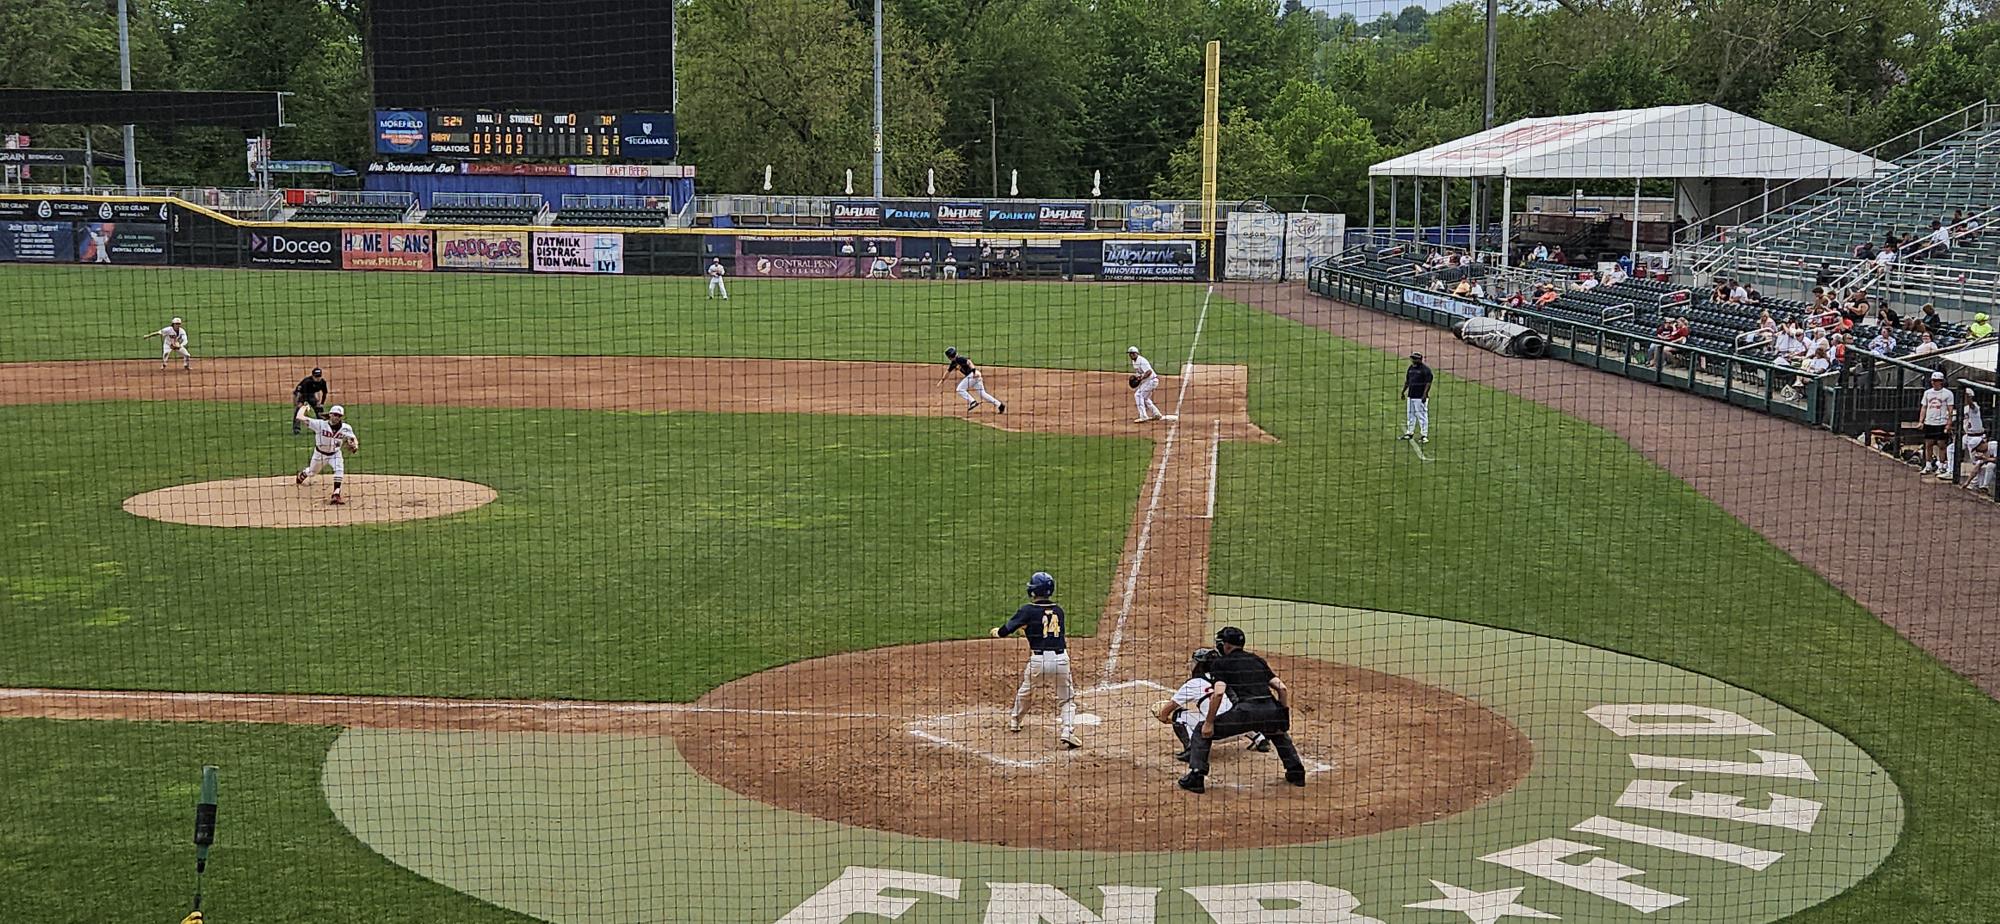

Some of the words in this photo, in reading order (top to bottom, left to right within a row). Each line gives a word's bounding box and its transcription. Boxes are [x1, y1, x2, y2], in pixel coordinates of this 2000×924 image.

[476, 114, 493, 123] BALL
[509, 115, 534, 124] STRIKE
[554, 115, 567, 124] OUT
[380, 120, 423, 129] MOREFIELD
[473, 133, 480, 143] 0
[484, 133, 491, 143] 0
[495, 133, 501, 143] 3
[505, 133, 512, 143] 0
[586, 134, 593, 144] 3
[473, 144, 480, 154] 0
[484, 144, 491, 154] 2
[505, 144, 512, 154] 0
[369, 162, 383, 171] the
[386, 162, 434, 172] Scoreboard
[436, 163, 455, 172] Bar
[606, 166, 626, 175] CRAFT
[629, 166, 648, 176] BEERS
[895, 210, 930, 218] DAIKIN
[999, 210, 1035, 219] DAIKIN
[273, 236, 331, 253] Doceo
[388, 233, 429, 254] LOANS
[537, 237, 580, 247] OATMILK
[537, 247, 580, 257] DISTRAC-
[352, 257, 423, 269] www.PHFA.org
[537, 257, 560, 267] TION
[774, 258, 813, 269] CENTRAL
[814, 259, 838, 270] PENN
[1104, 267, 1154, 275] INNOVATIVE
[1155, 267, 1195, 275] COACHES
[1476, 704, 1823, 913] FIELD
